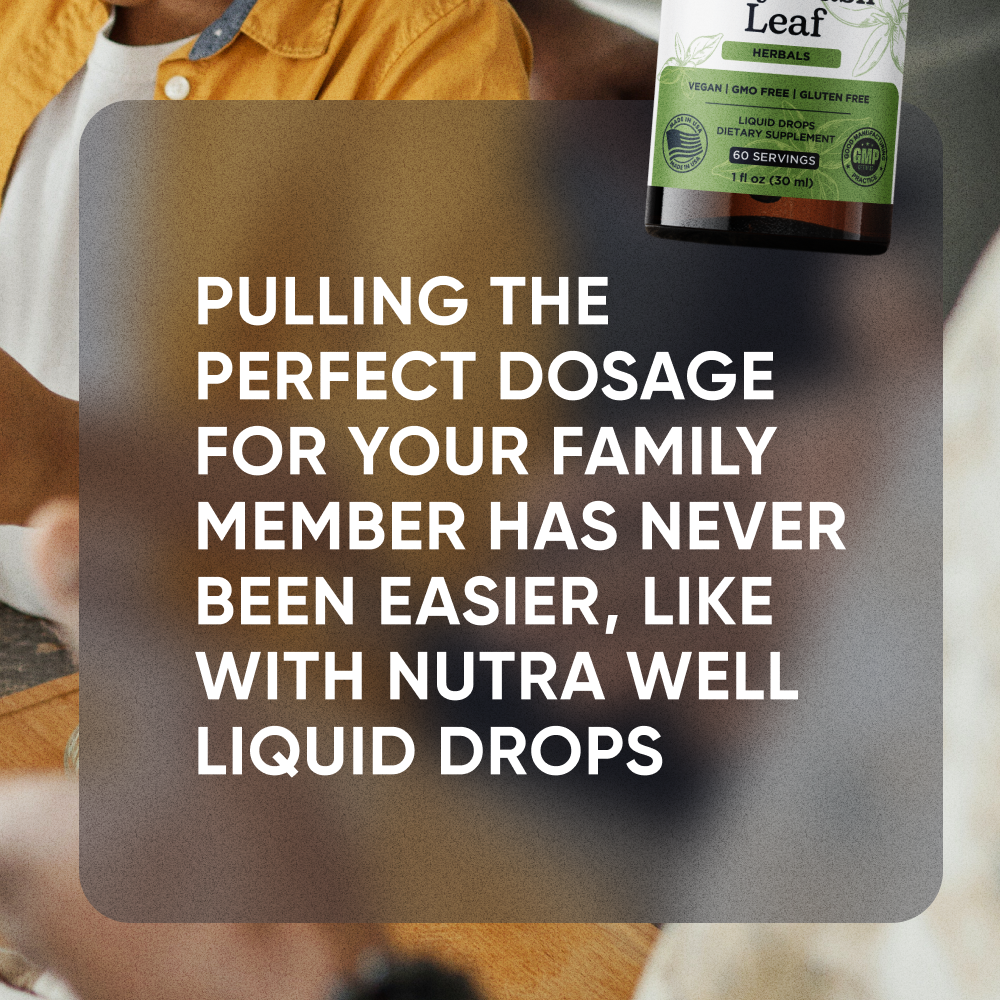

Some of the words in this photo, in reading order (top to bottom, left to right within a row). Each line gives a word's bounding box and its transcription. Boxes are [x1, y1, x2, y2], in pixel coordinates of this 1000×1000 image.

[744, 2, 828, 37] Leaf
[752, 48, 810, 61] HERBALS
[688, 81, 722, 93] VEGAN
[732, 85, 757, 96] GMO
[761, 88, 790, 98] FREE
[800, 90, 843, 102] GLUTEN
[846, 94, 870, 104] FREE
[670, 116, 684, 129] MADE
[692, 120, 703, 134] USA
[738, 116, 775, 127] LIQUID
[778, 119, 815, 130] DROPS
[716, 127, 763, 138] DIETARY
[765, 130, 836, 143] SUPPLEMENT
[843, 139, 854, 159] GOOD
[852, 147, 880, 165] GMP
[670, 160, 684, 170] MADE
[690, 156, 701, 167] USA
[732, 150, 749, 160] 60
[753, 152, 816, 166] SERVINGS
[731, 172, 736, 182] 1
[739, 173, 747, 183] fl
[751, 176, 766, 184] oz
[769, 175, 791, 186] (30
[794, 177, 814, 189] ml)
[851, 172, 878, 184] PRACTICE
